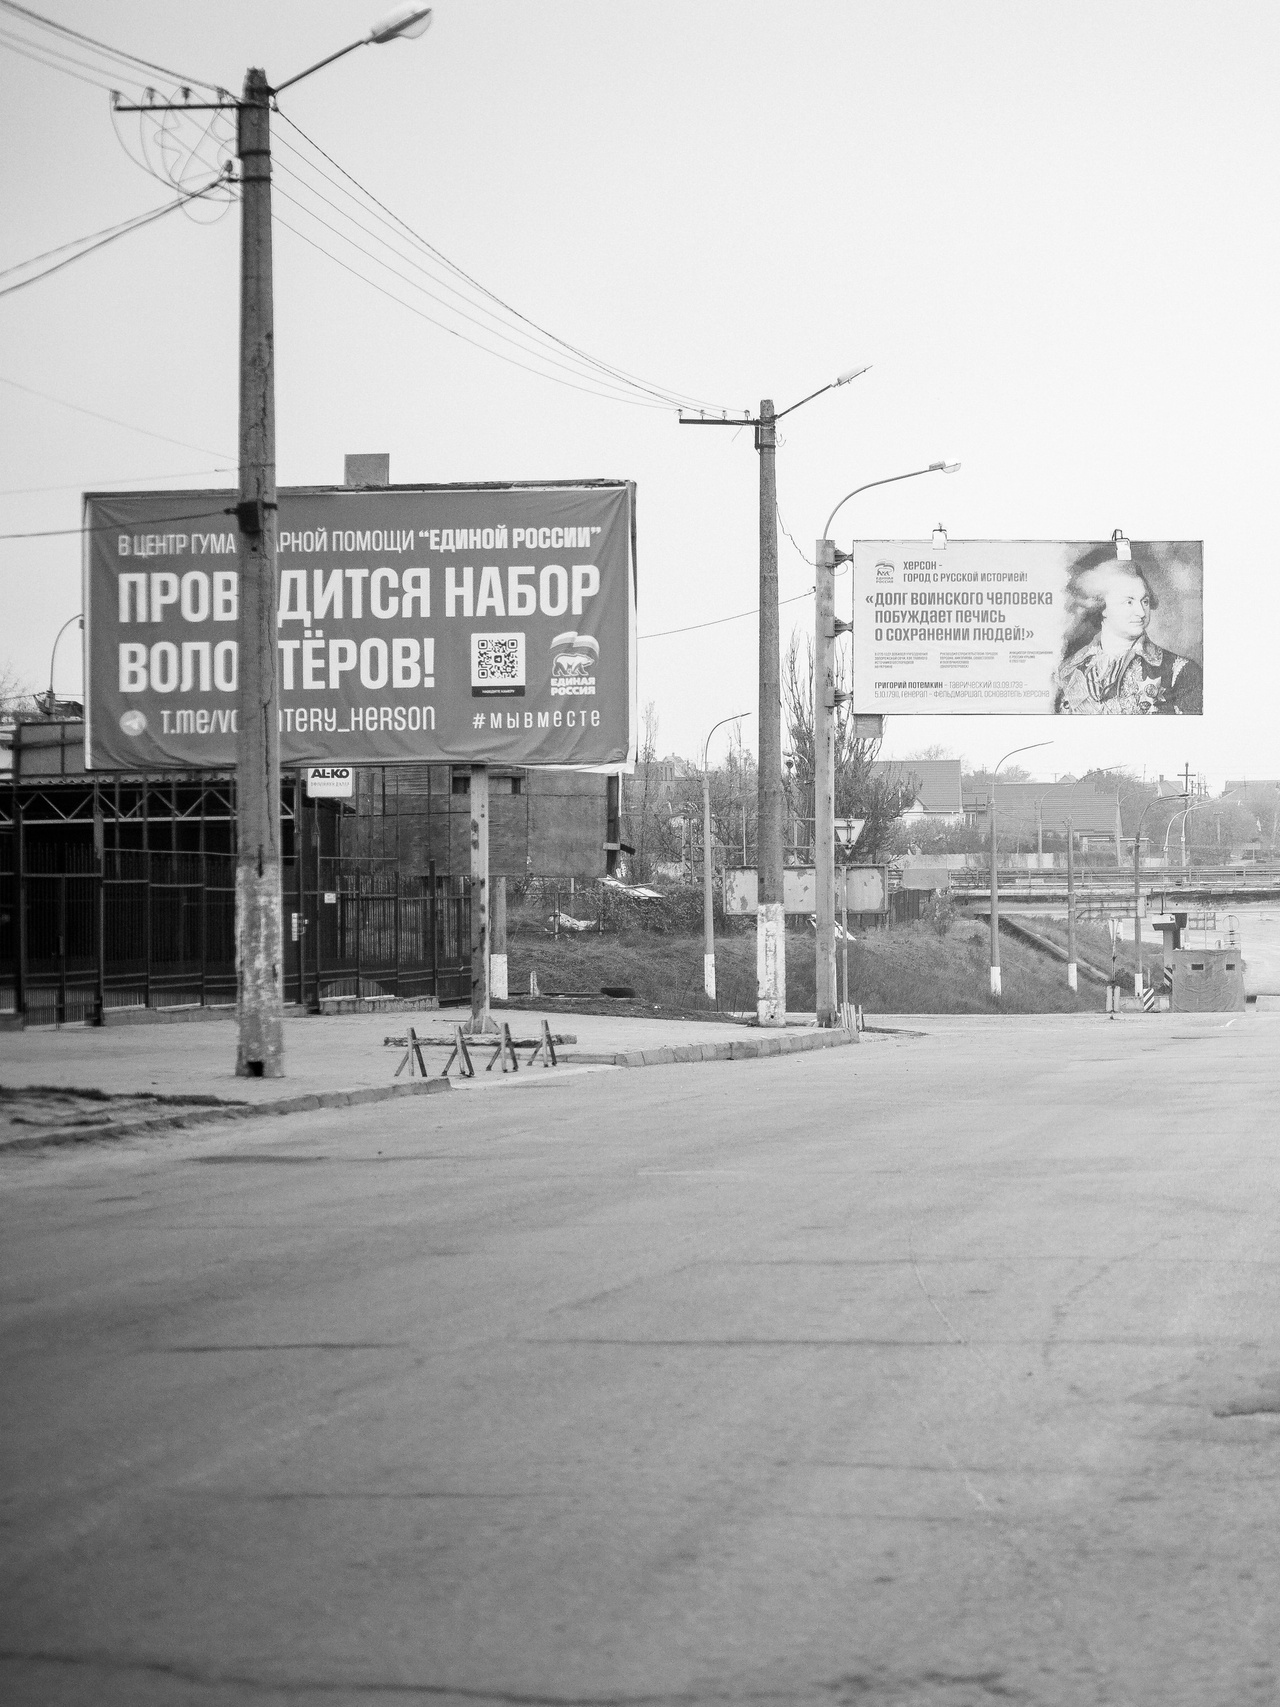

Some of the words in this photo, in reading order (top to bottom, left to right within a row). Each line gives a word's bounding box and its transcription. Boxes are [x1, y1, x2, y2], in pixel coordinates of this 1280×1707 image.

[118, 534, 131, 556] В
[133, 534, 189, 559] ЦЕНТР
[332, 529, 415, 554] ПОМОЩИ
[903, 573, 931, 583] ГОРОД
[933, 573, 938, 582] С
[940, 571, 979, 582] РУССКОЙ
[118, 567, 431, 628] ПРОВДИТСЯ
[445, 564, 601, 618] НАБОР
[911, 591, 984, 606] ВОИНСКОГО
[875, 628, 883, 641] О
[118, 629, 435, 693] ВОЛОТЁРОВ!
[550, 677, 596, 687] ЕДИНАЯ
[874, 681, 907, 689] ГРИГОРИЙ
[550, 686, 596, 696] РОССИЯ
[310, 768, 350, 778] AL-KO
